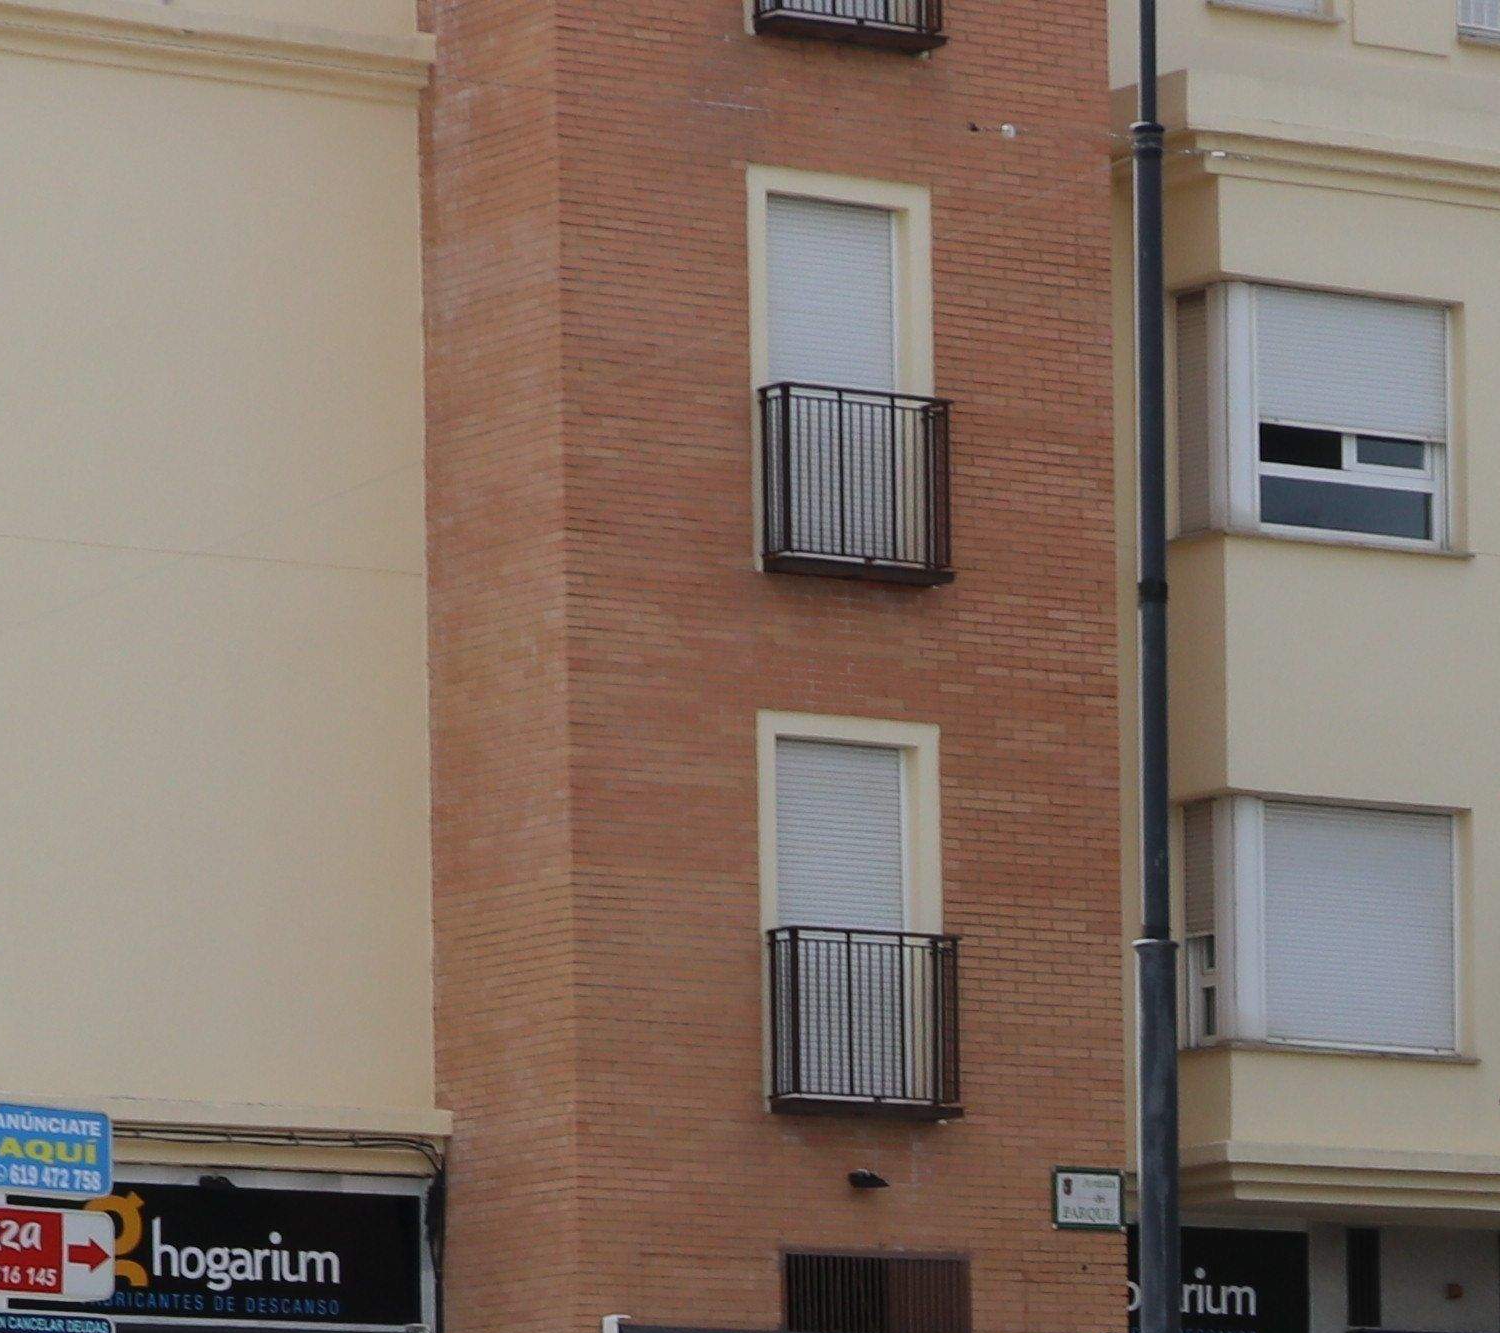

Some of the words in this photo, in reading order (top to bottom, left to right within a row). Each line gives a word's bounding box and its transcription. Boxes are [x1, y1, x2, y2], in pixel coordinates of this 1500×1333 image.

[0, 1136, 98, 1164] AQUÍ
[152, 1216, 341, 1292] hogarium
[26, 1266, 57, 1287] 145
[214, 1296, 236, 1313] DE
[246, 1297, 341, 1316] DESCANSO
